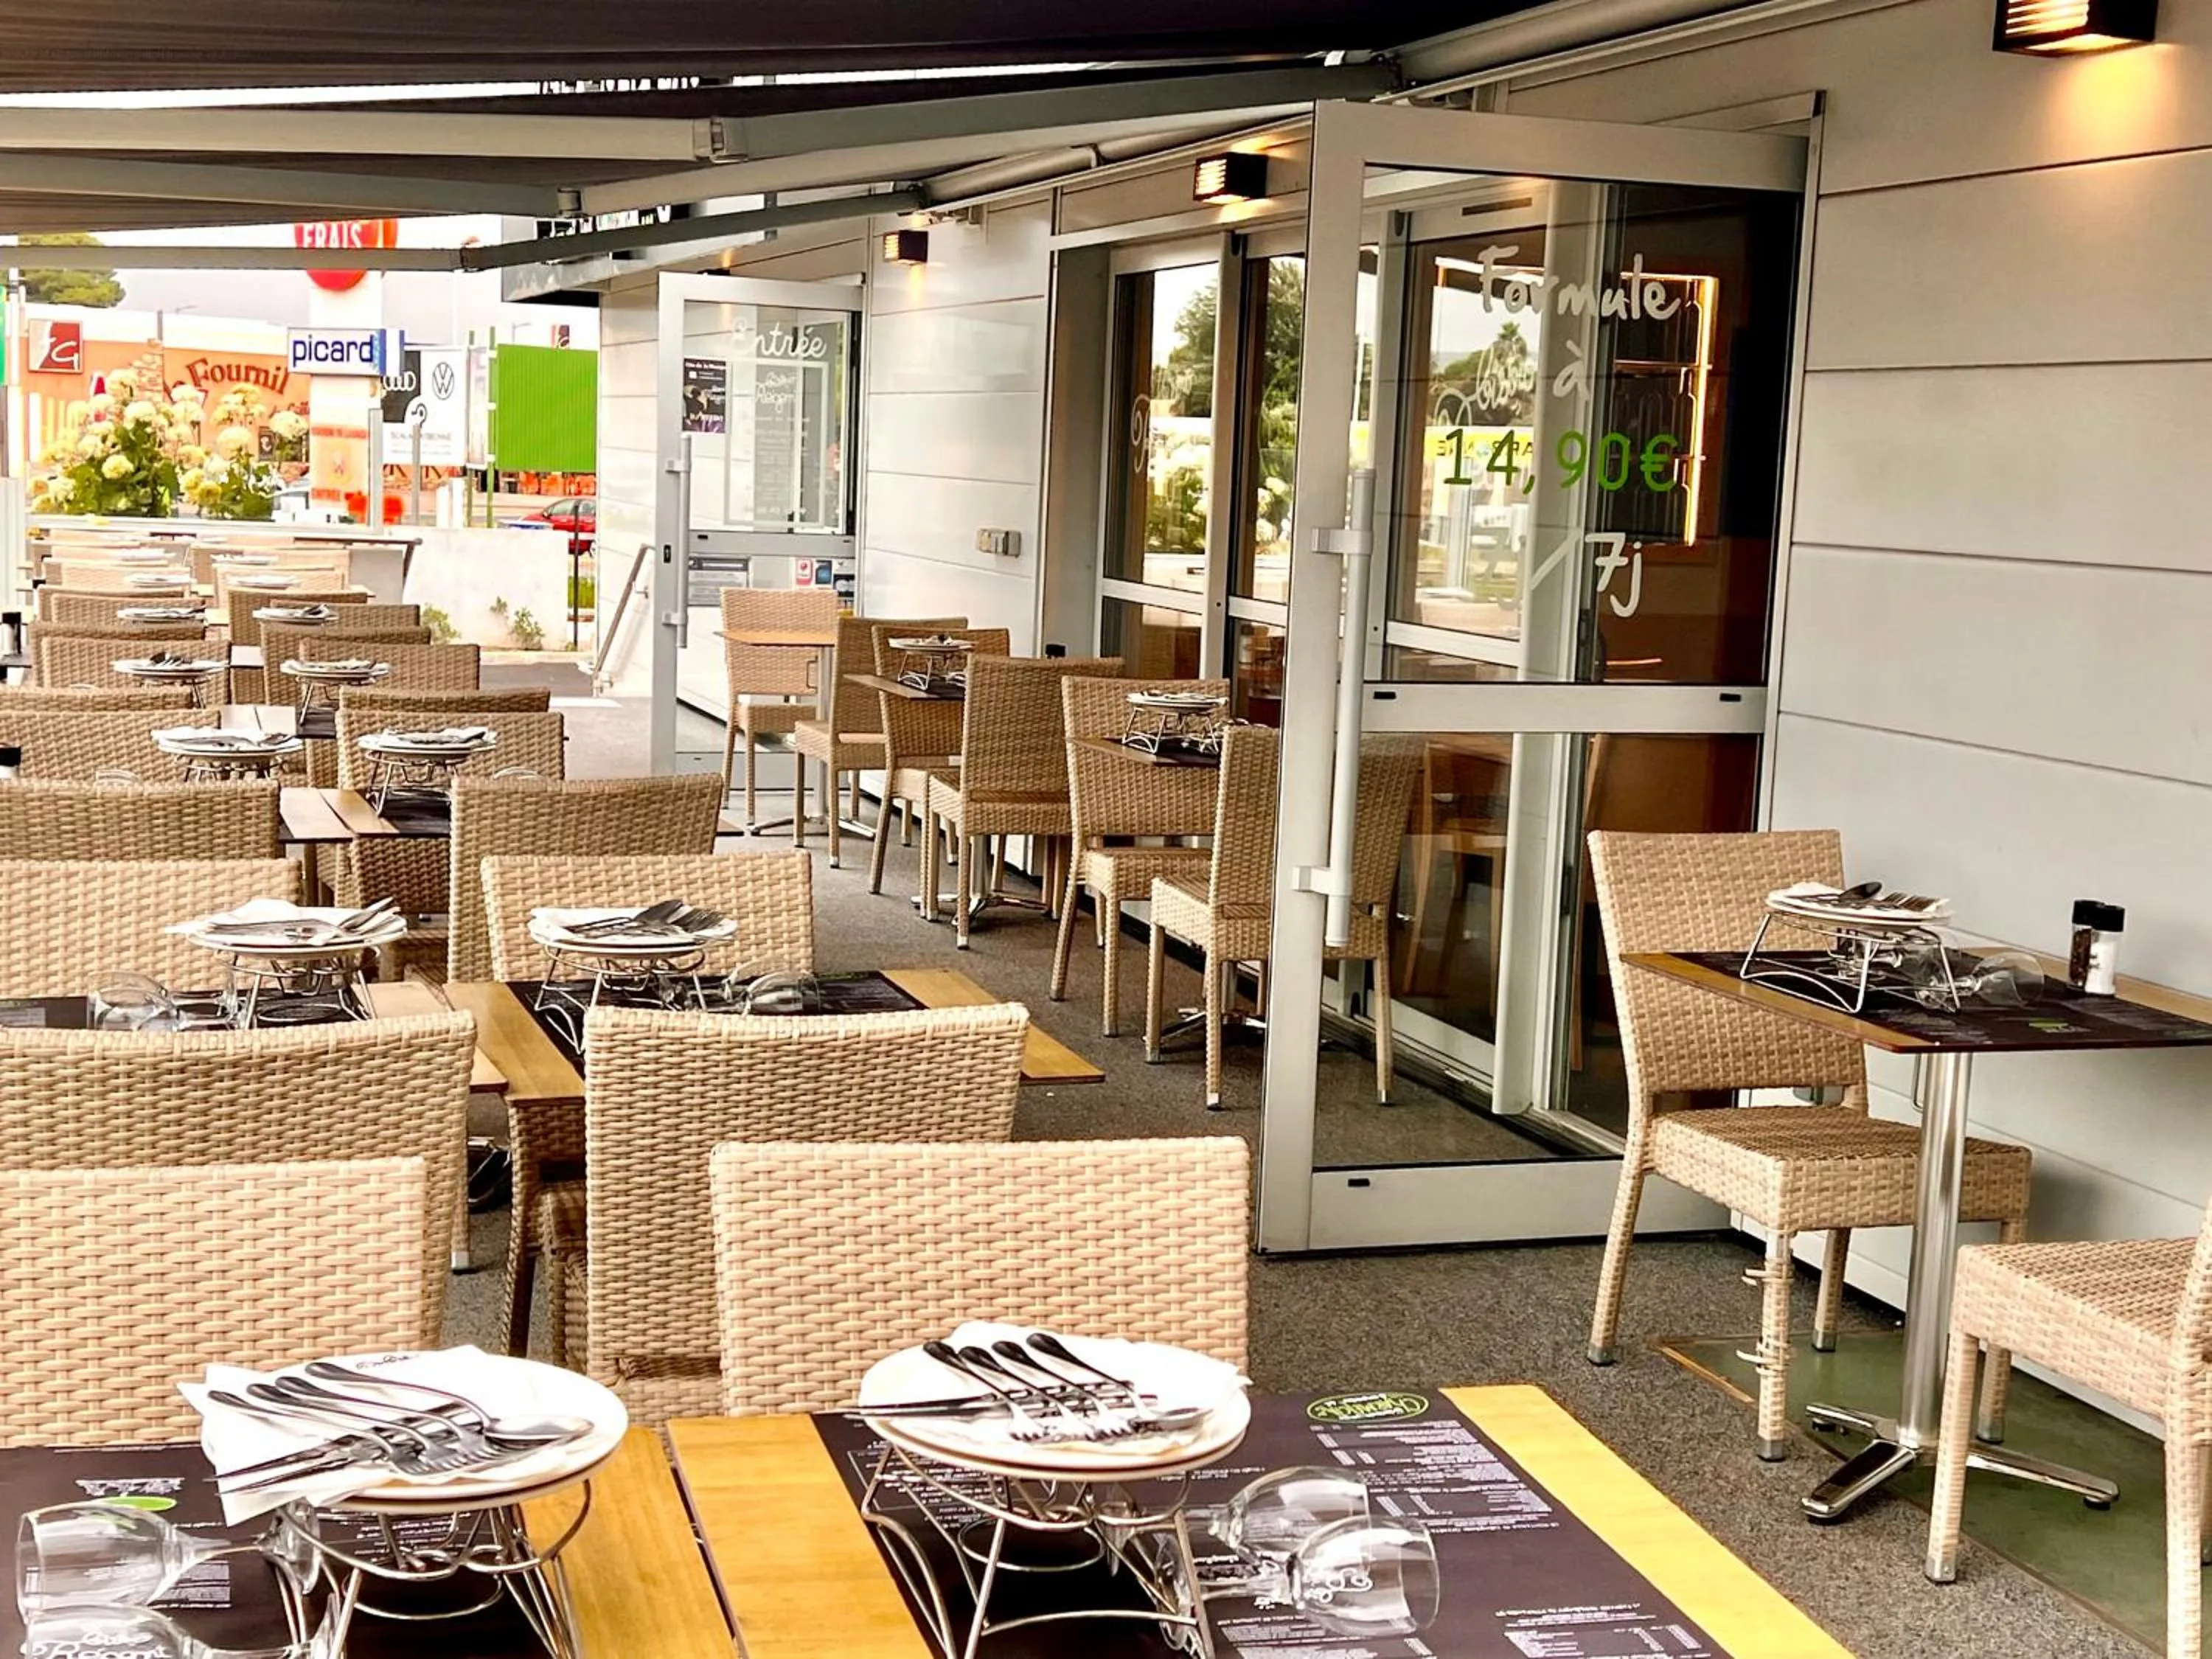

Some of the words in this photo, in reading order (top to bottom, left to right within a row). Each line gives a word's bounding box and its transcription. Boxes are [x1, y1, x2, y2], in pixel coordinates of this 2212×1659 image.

[1477, 244, 1682, 320] Formule
[293, 334, 374, 368] picard
[731, 316, 827, 358] Entrée
[186, 357, 291, 395] Fournil
[1554, 340, 1590, 401] à
[1443, 428, 1679, 495] 14,90€
